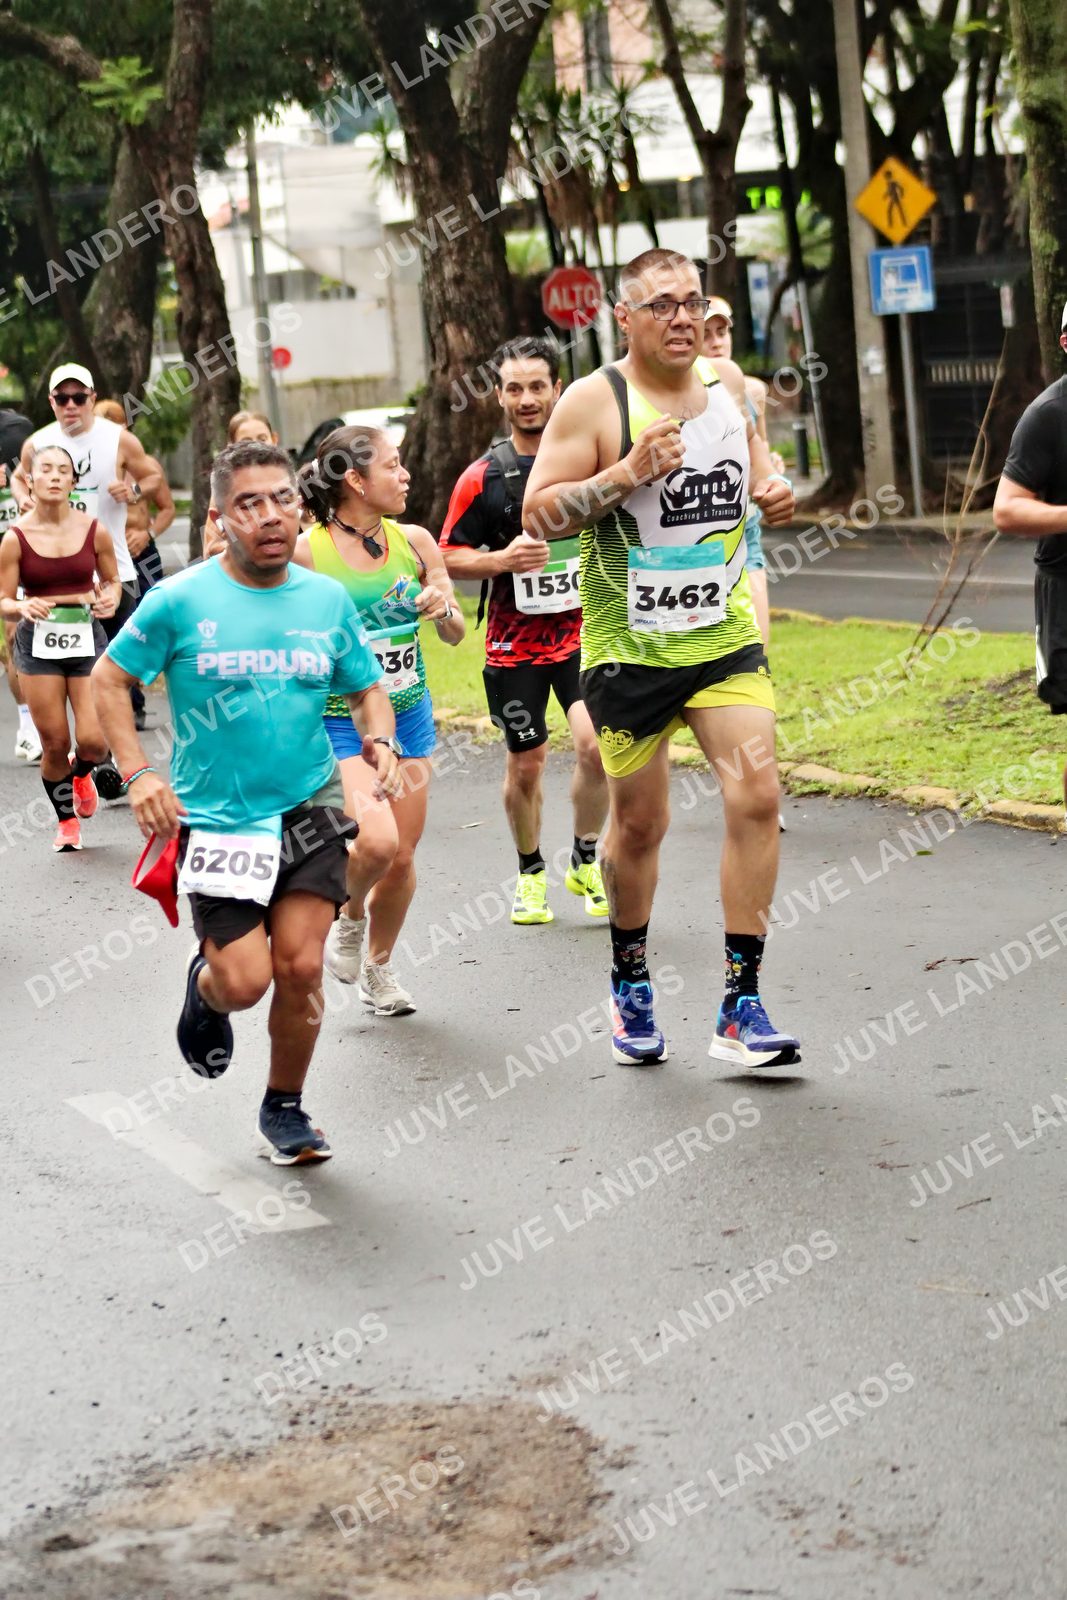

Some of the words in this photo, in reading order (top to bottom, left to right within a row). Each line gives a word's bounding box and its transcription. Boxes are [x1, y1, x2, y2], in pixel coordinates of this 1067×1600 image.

[548, 283, 597, 312] ALTO
[684, 481, 727, 498] RINOS
[667, 513, 700, 523] Coaching
[711, 508, 737, 518] Training
[635, 582, 720, 611] 3462
[45, 632, 82, 649] 662
[197, 649, 331, 676] PERDURA
[189, 846, 274, 880] 6205
